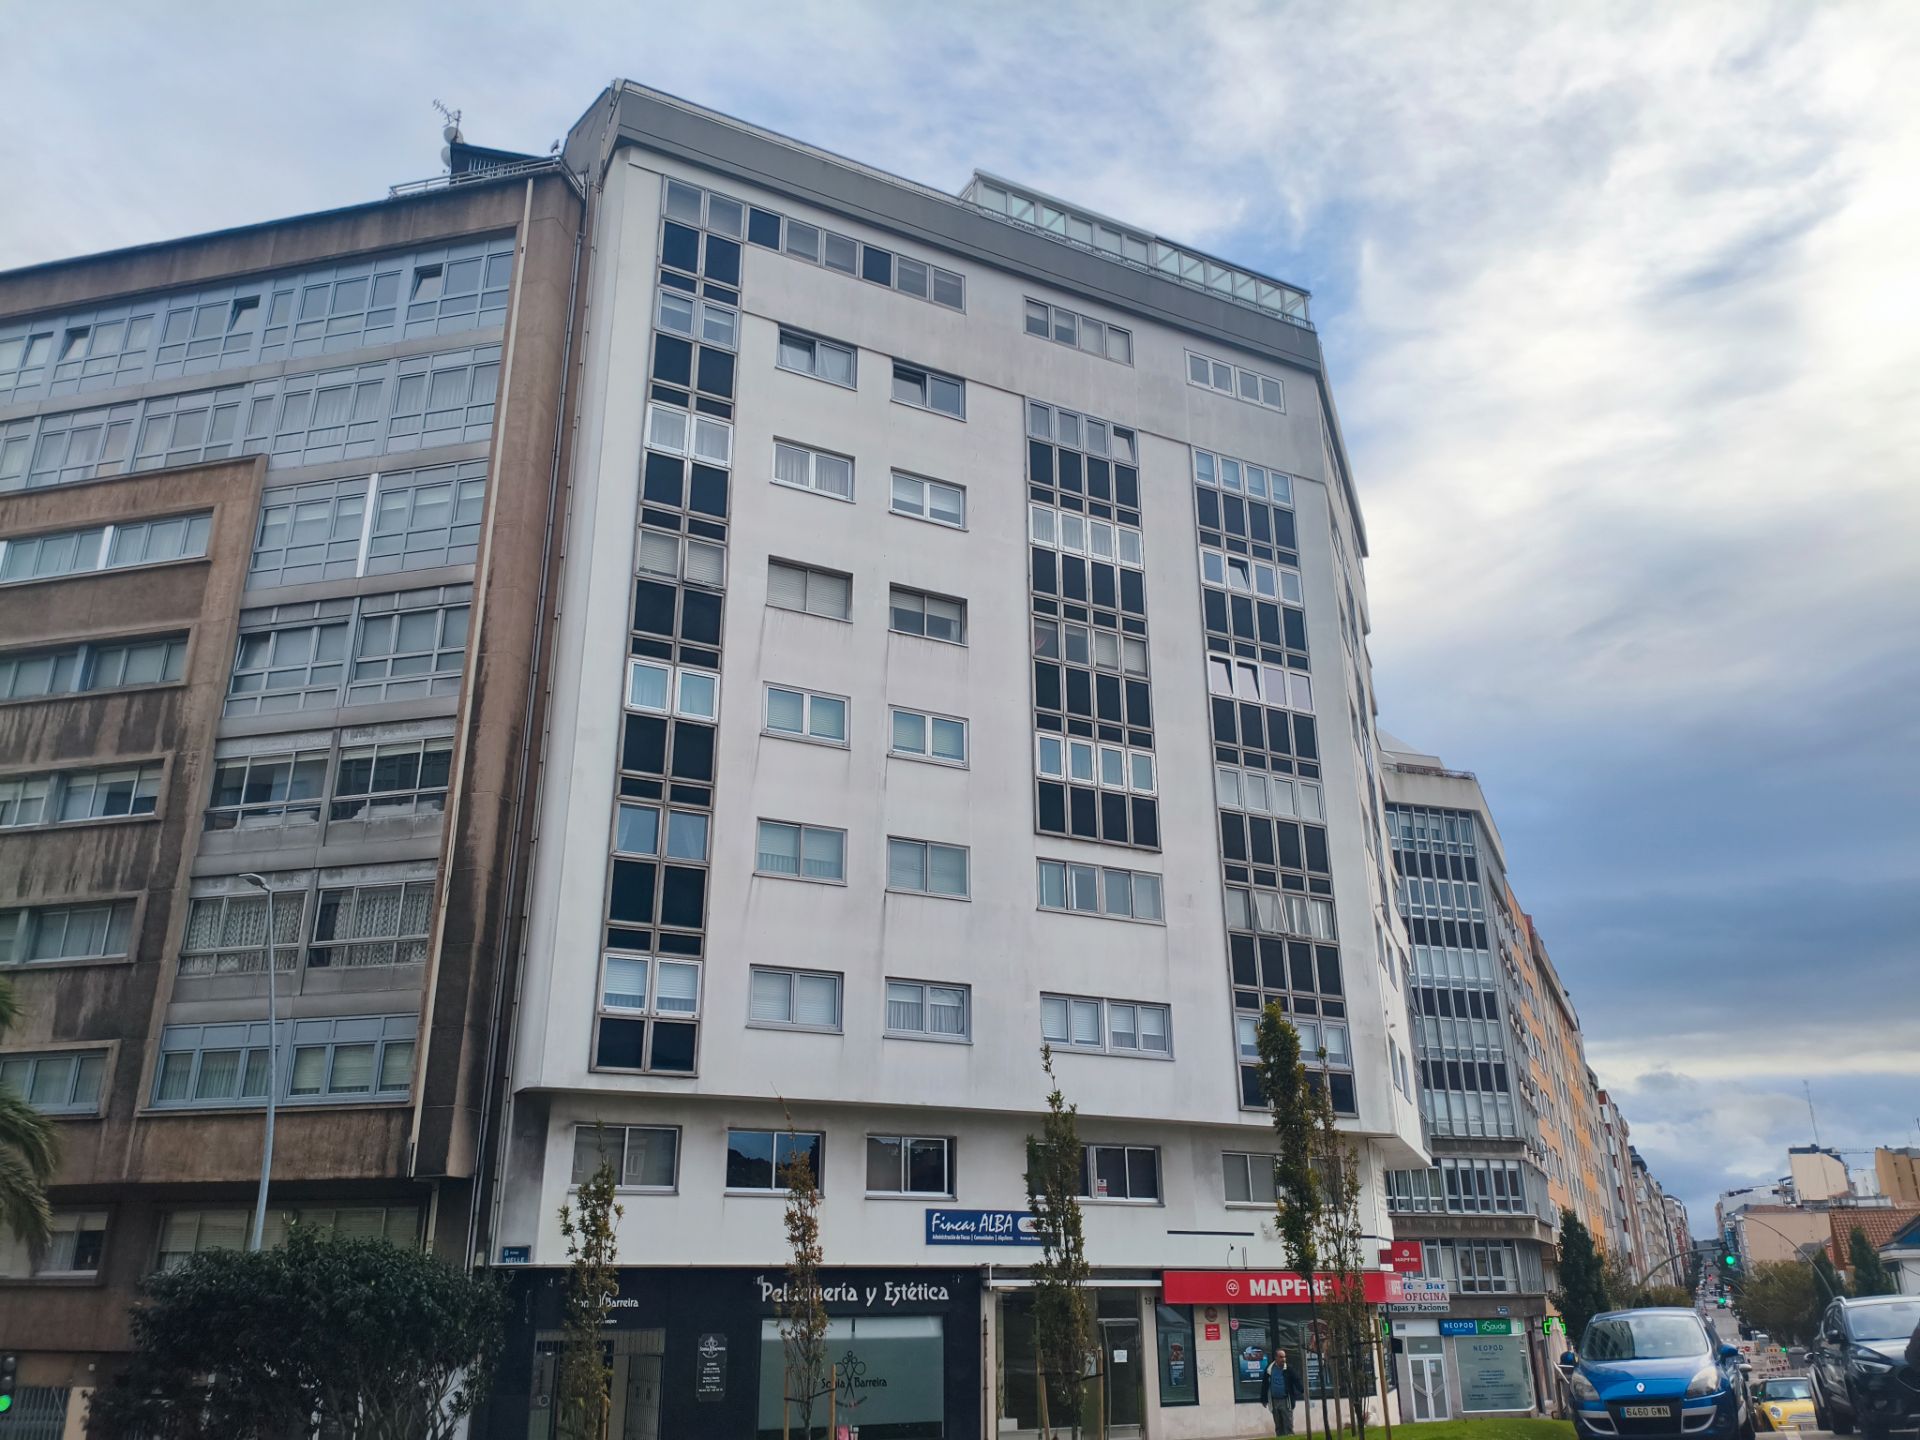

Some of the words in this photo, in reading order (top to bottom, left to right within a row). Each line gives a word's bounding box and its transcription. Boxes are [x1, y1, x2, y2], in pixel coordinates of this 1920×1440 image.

[932, 1213, 976, 1232] Fincas
[979, 1213, 1013, 1233] ALBA
[1426, 1282, 1445, 1290] Bar
[866, 1286, 877, 1307] y
[884, 1282, 949, 1306] Estética
[1405, 1293, 1447, 1301] OFICINA
[821, 1378, 845, 1388] Soia
[854, 1377, 887, 1387] Barreira
